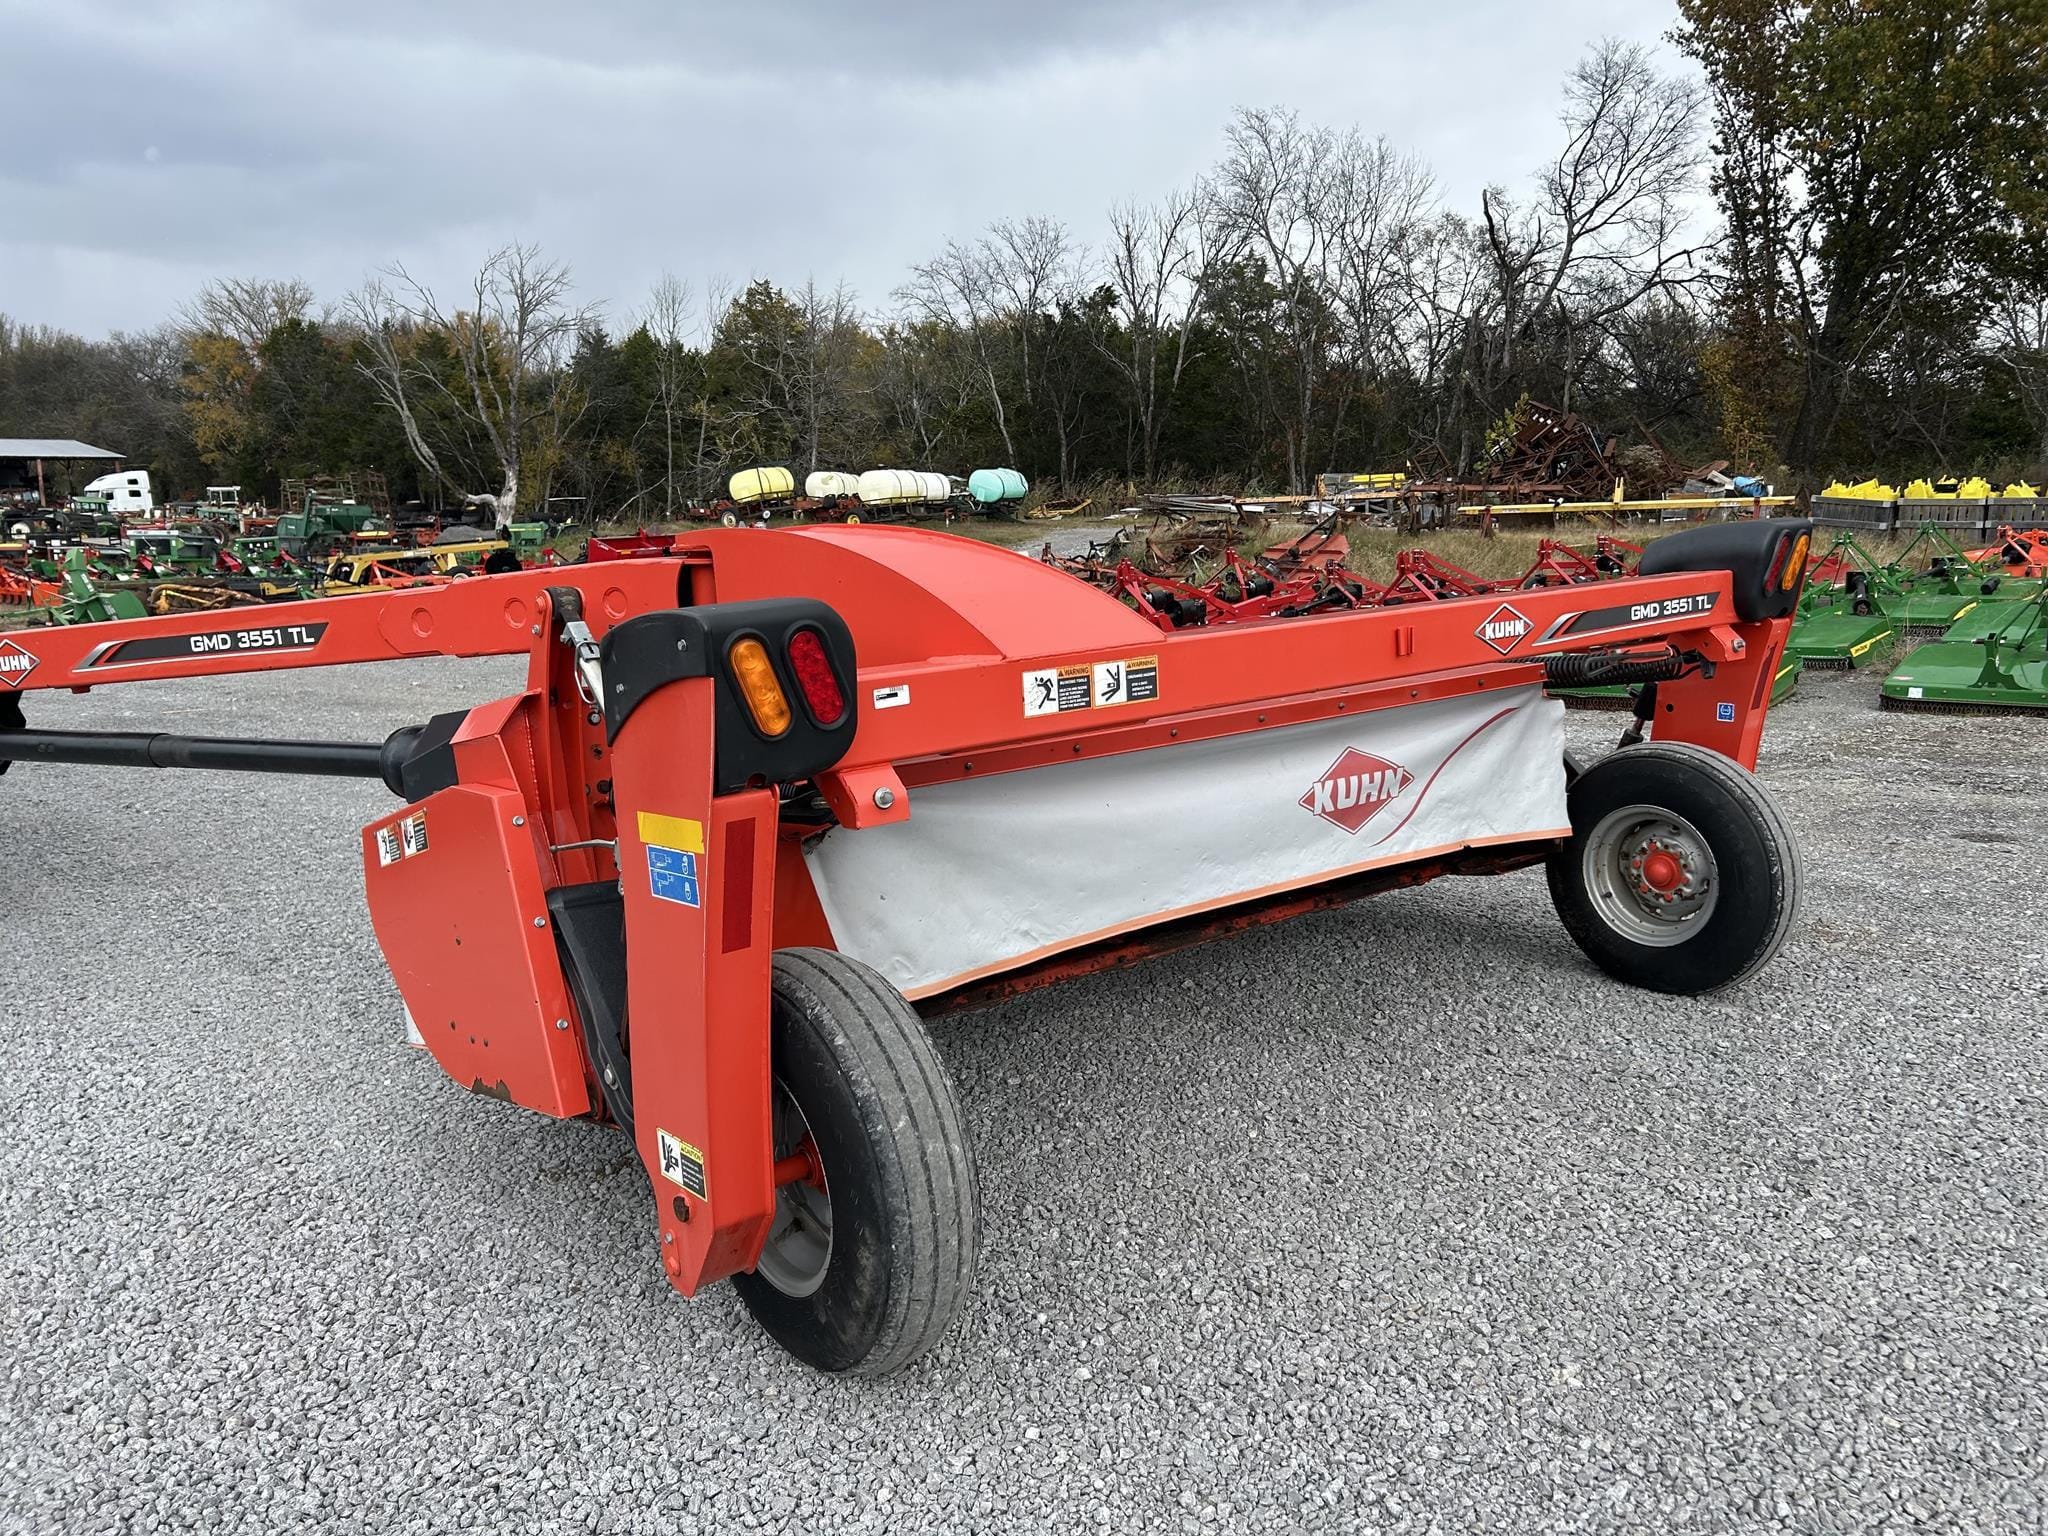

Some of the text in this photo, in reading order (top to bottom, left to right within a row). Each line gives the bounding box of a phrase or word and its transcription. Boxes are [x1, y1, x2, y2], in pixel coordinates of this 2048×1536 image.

[1631, 595, 1712, 621] GMD 3551 TL
[190, 627, 315, 652] GMD 3551 TL
[1485, 619, 1524, 640] KUHN
[0, 655, 30, 672] UHN
[1064, 667, 1089, 677] WARNING
[1313, 766, 1404, 816] KUHN
